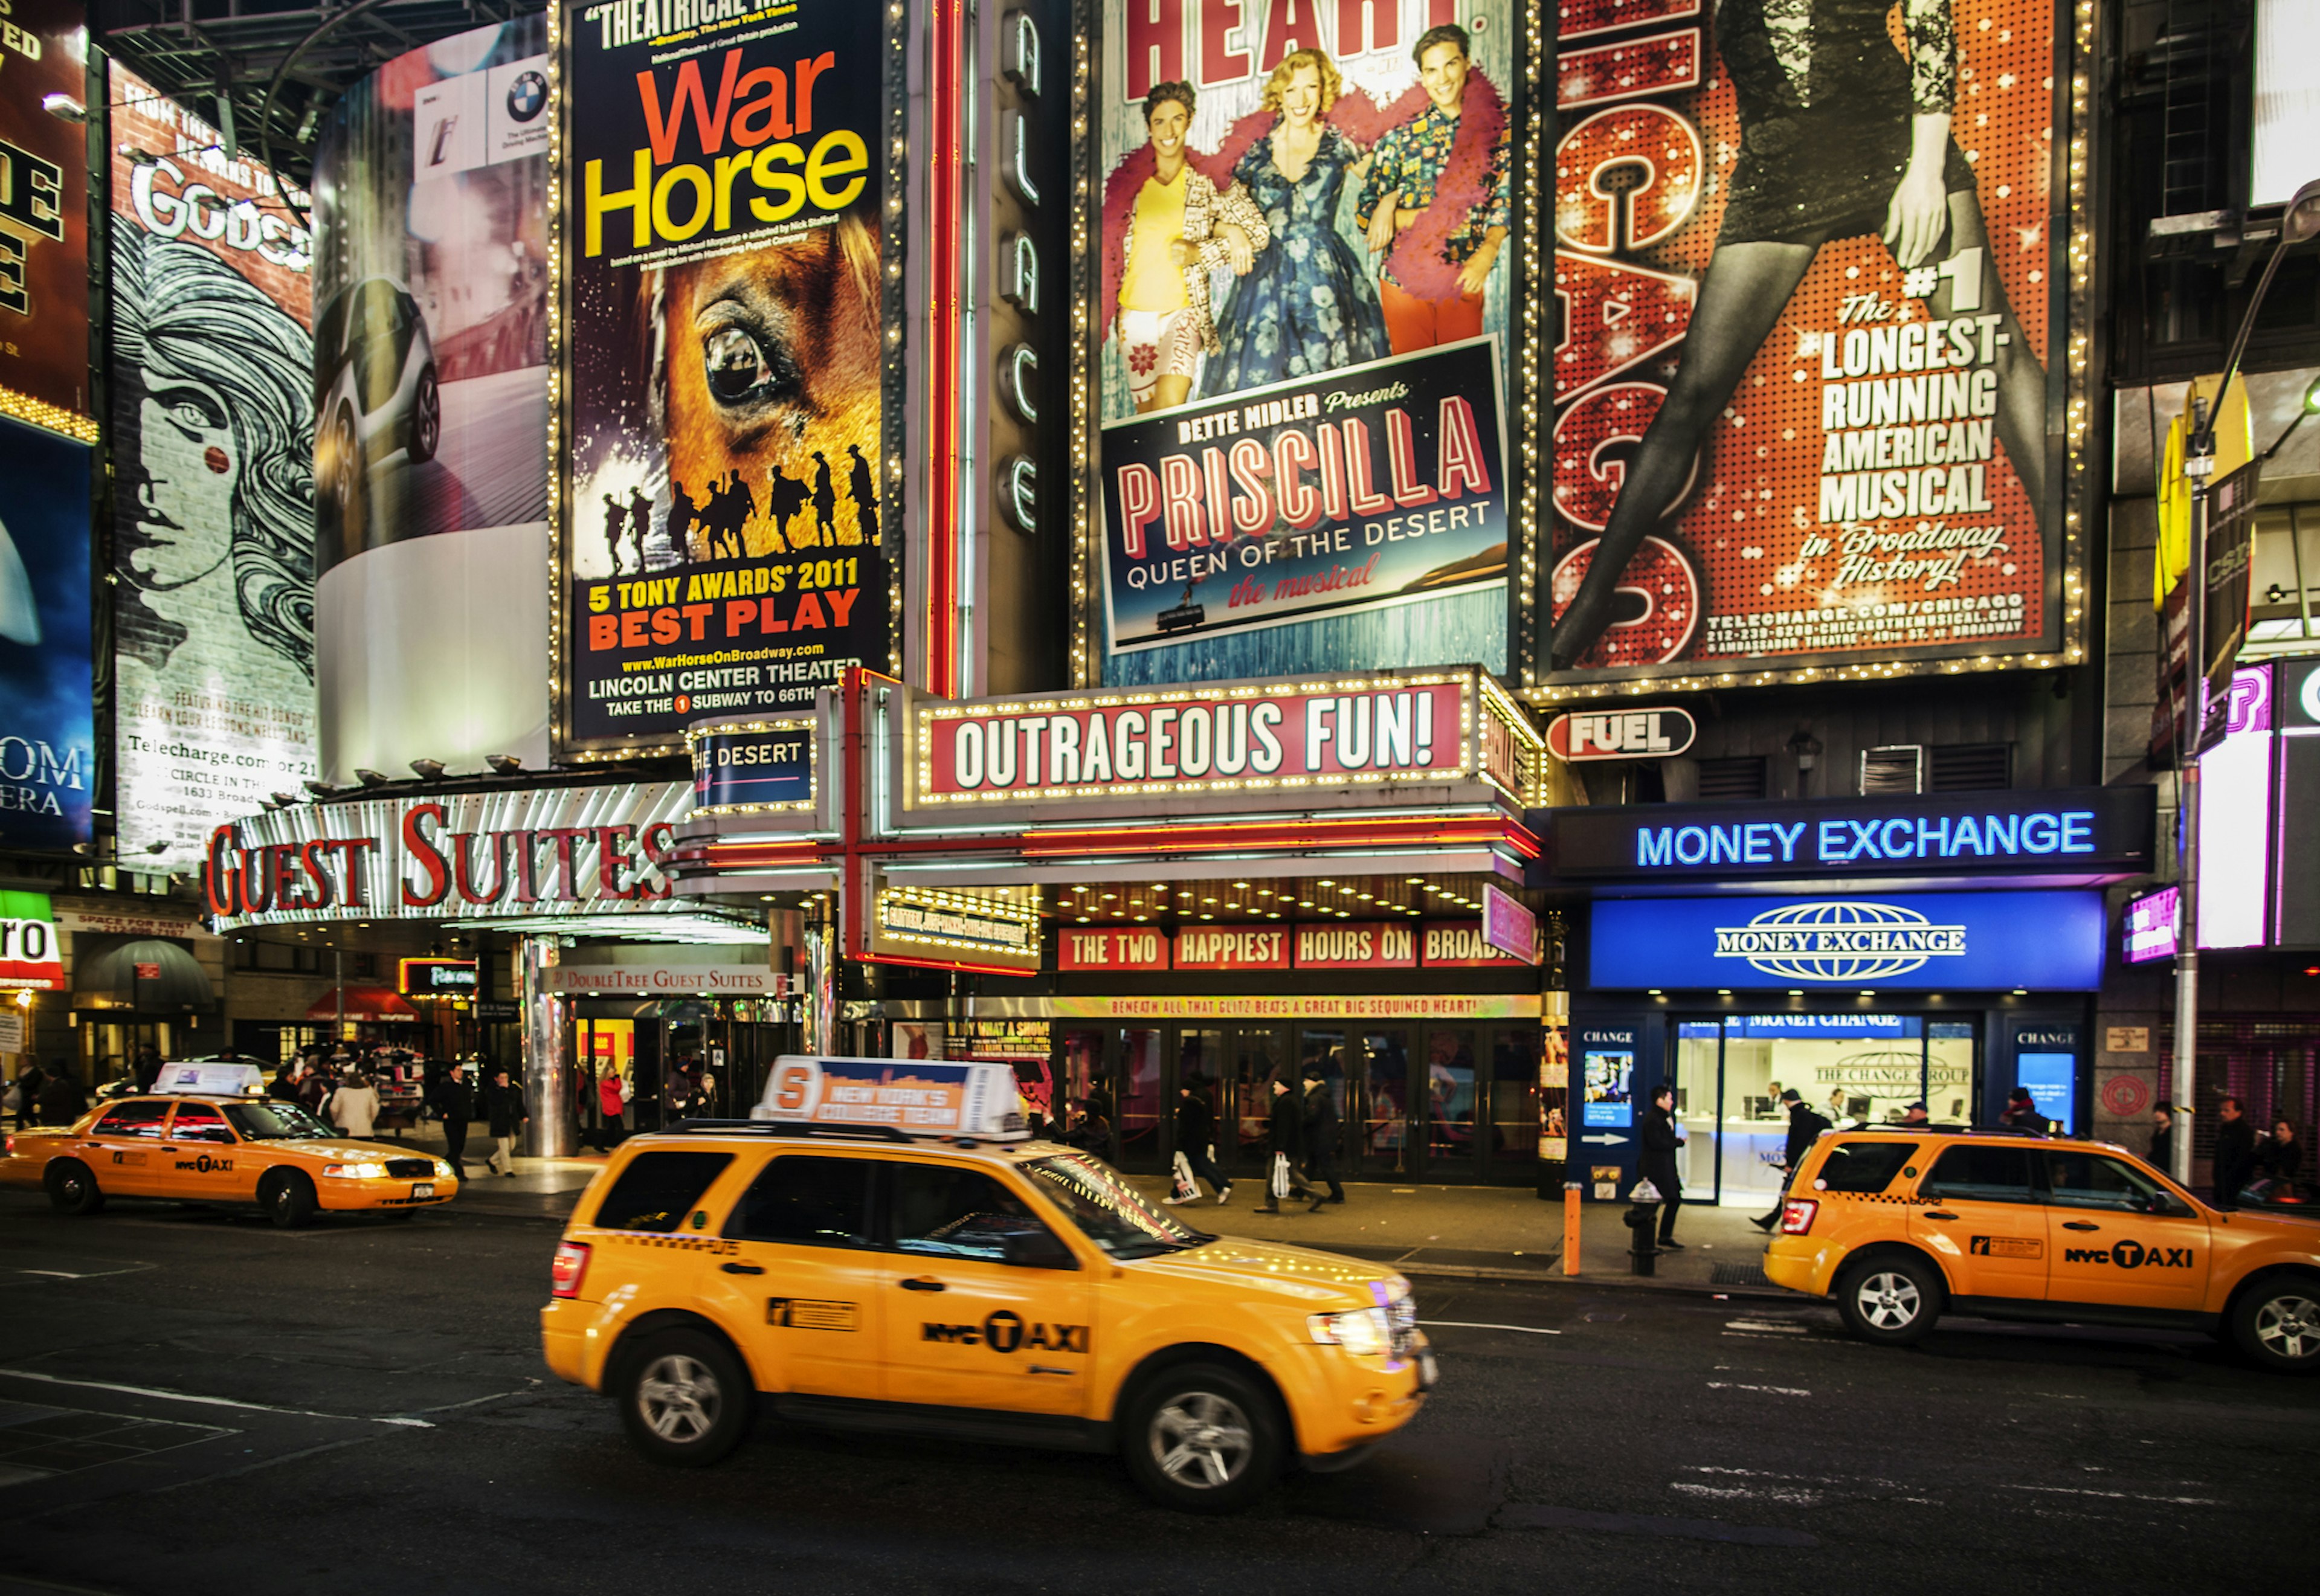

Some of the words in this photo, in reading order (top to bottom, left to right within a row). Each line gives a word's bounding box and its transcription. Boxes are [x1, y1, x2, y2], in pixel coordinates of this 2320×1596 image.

[699, 24, 718, 34] The
[718, 17, 741, 29] New
[741, 11, 765, 24] York
[765, 4, 798, 19] Times
[123, 82, 176, 128] FROM
[179, 109, 212, 144] THE
[636, 48, 835, 167] War
[585, 129, 869, 259] Horse
[610, 254, 633, 268] based
[649, 247, 668, 260] novel
[668, 246, 677, 258] by
[779, 222, 790, 234] by
[790, 218, 808, 232] Nick
[808, 213, 840, 228] Stafford
[772, 231, 809, 247] Company
[1901, 245, 1983, 312] #1
[1838, 290, 1895, 324] The
[1822, 313, 2010, 380] LONGEST-
[1178, 408, 1240, 445] BETTE
[1243, 393, 1320, 431] MIDLER
[1324, 381, 1409, 413] Presents
[1822, 368, 1997, 431] RUNNING
[1821, 419, 1993, 474] AMERICAN
[1117, 394, 1493, 561] PRISCILLA
[1817, 464, 1993, 524] MUSICAL
[1127, 550, 1227, 590] QUEEN
[1240, 543, 1277, 569] OF
[1290, 528, 1352, 558] THE
[1365, 500, 1491, 545] DESERT
[1800, 532, 1829, 558] in
[1841, 520, 2010, 556] Broadway
[588, 585, 610, 613] 5
[617, 576, 681, 610] TONY
[797, 556, 859, 590] 2011
[1228, 573, 1267, 609] the
[1273, 552, 1382, 602] musical
[1834, 549, 1969, 591] History!
[588, 603, 714, 652] BEST
[726, 588, 861, 638] PLAY
[1706, 592, 2023, 630] TELECHARGE.COM/CHICAGO
[1718, 636, 1799, 654] AMBASSADOR
[1805, 632, 1858, 648] THEATRE
[1951, 620, 2023, 637] BROADWAY
[622, 643, 824, 674] www.WarHorseOnBroadway.com
[588, 669, 673, 700] LINCOLN
[678, 664, 761, 692] CENTER
[233, 702, 251, 718] THE
[606, 700, 642, 717] TAKE
[643, 697, 674, 714] THE
[691, 692, 752, 710] SUBWAY
[754, 690, 776, 704] TO
[777, 687, 816, 703] 66TH
[954, 701, 1283, 789] OUTRAGEOUS
[1304, 691, 1434, 772] FUN!
[1570, 713, 1672, 754] FUEL
[127, 735, 269, 768] Telecharge.com
[277, 760, 295, 773] or
[717, 741, 803, 767] DESERT
[170, 768, 220, 786] CIRCLE
[224, 776, 239, 788] IN
[183, 786, 213, 799] 1633
[1637, 820, 1806, 866] MONEY
[1817, 811, 2095, 862] EXCHANGE
[206, 823, 380, 918] GUEST
[401, 802, 674, 908] SUITES
[79, 914, 122, 926] SPACE
[127, 917, 155, 928] FOR
[158, 920, 193, 931] RENT
[1071, 935, 1109, 964] THE
[1116, 935, 1158, 964] TWO
[1181, 932, 1283, 964] HAPPIEST
[1300, 930, 1373, 962] HOURS
[1381, 930, 1413, 960] ON
[1715, 930, 1812, 953] MONEY
[1816, 930, 1967, 951] EXCHANGE
[653, 970, 704, 988] GUEST
[709, 970, 764, 988] SUITES
[1163, 1000, 1182, 1014] ALL
[1187, 1000, 1214, 1014] THAT
[1218, 1000, 1251, 1014] GLITZ
[1255, 1000, 1289, 1014] BEATS
[1293, 1000, 1300, 1013] A
[1304, 1000, 1341, 1014] GREAT
[1345, 1000, 1365, 1014] BIG
[1370, 1000, 1429, 1015] SEQUINED
[1434, 1000, 1477, 1014] HEART!
[977, 1021, 1006, 1037] WHAT
[1007, 1021, 1016, 1037] A
[1583, 1031, 1634, 1044] CHANGE
[2017, 1032, 2075, 1044] CHANGE
[1816, 1068, 1845, 1081] THE
[1848, 1068, 1912, 1082] CHANGE
[830, 1085, 875, 1105] NEW
[817, 1103, 901, 1124] COLLEGE
[903, 1105, 959, 1126] TEAM
[175, 1160, 196, 1171] NYC
[197, 1155, 234, 1172] TAXI
[2065, 1248, 2109, 1264] NYC
[2113, 1241, 2194, 1269] TAXI
[920, 1321, 984, 1345] NYC
[986, 1311, 1090, 1354] TAXI
